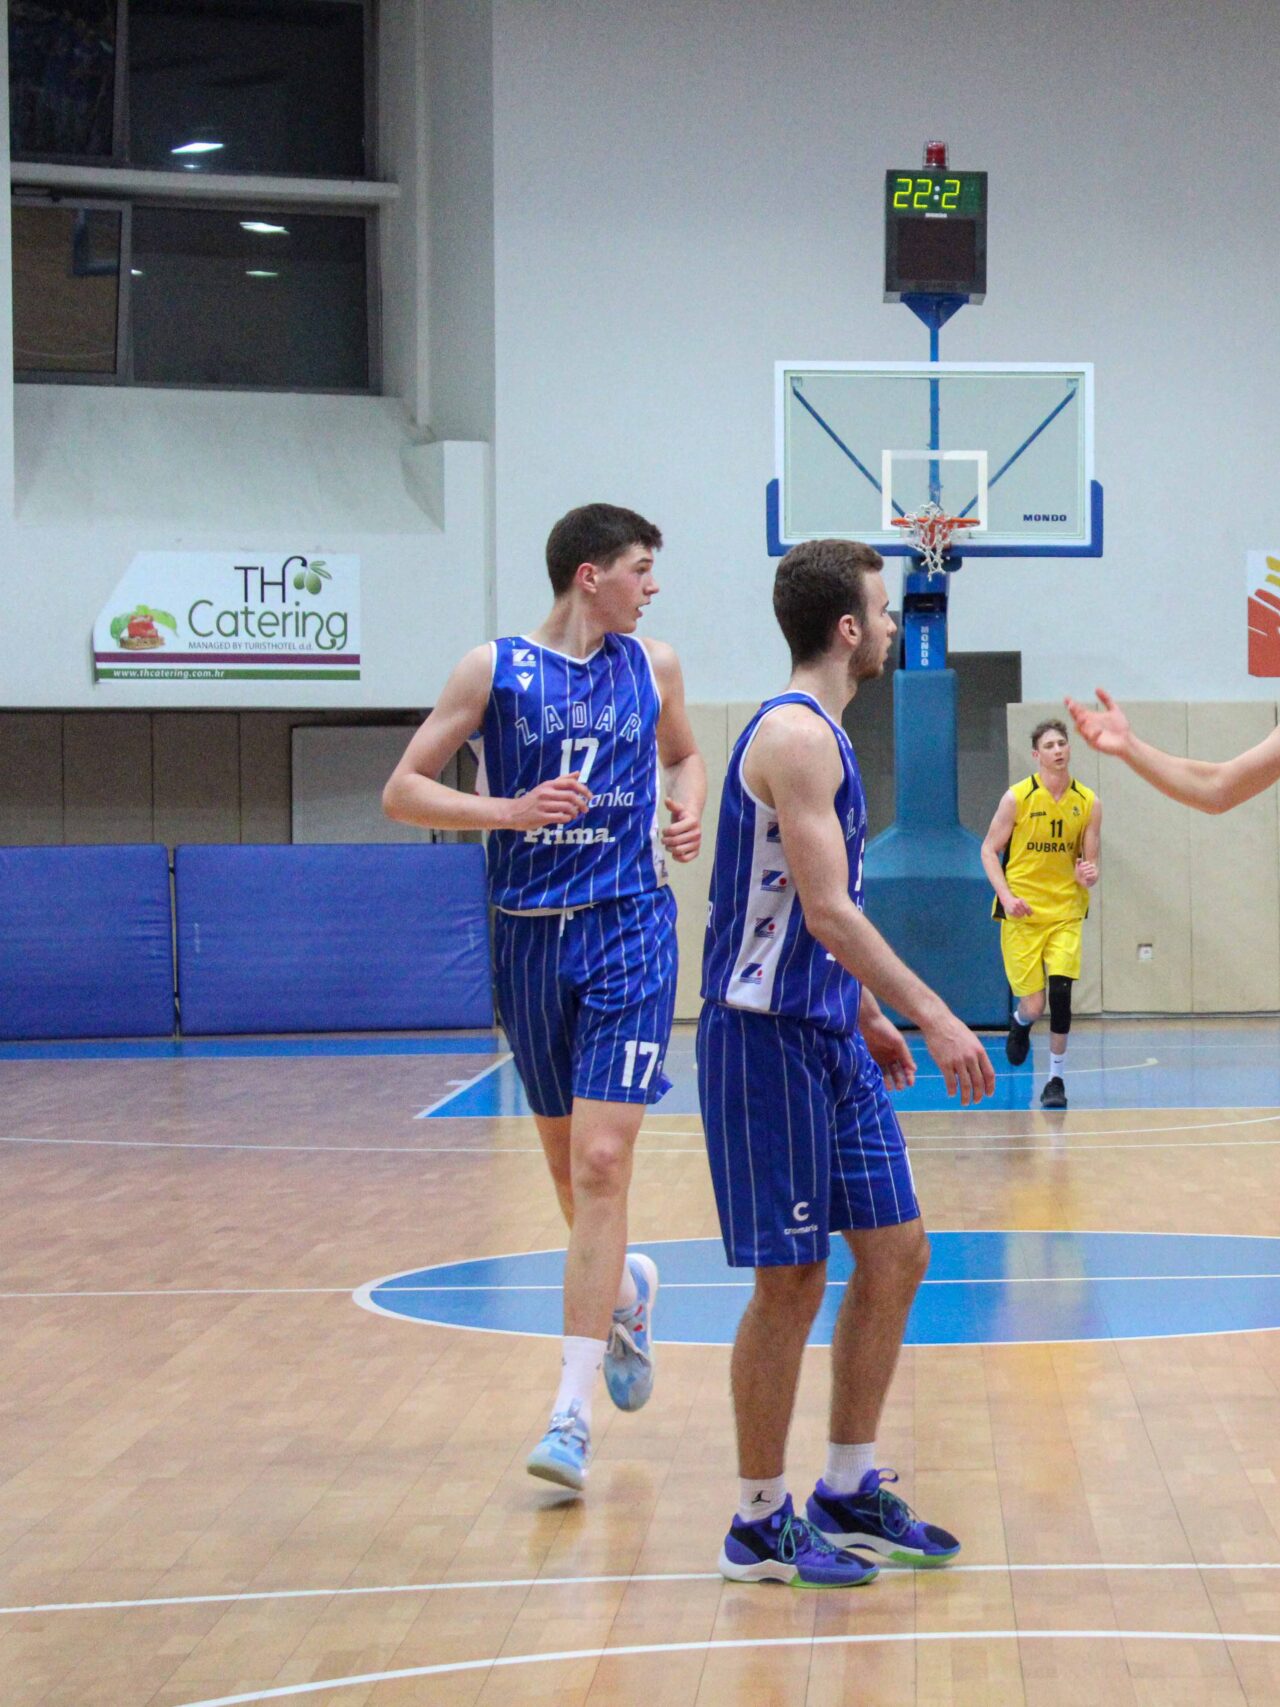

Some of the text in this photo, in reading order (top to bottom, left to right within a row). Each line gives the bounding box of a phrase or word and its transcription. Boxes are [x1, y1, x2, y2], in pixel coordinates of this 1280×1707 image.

[1022, 513, 1068, 523] MONDO
[188, 600, 348, 650] Catering
[188, 641, 231, 650] MANAGED
[232, 641, 243, 650] BY
[244, 641, 297, 651] TURISTHOTEL
[113, 668, 225, 680] www.thcatering.com.hr
[515, 702, 642, 746] ZADAR
[560, 737, 600, 784] 17
[1050, 819, 1063, 838] 11
[621, 1040, 660, 1089] 17
